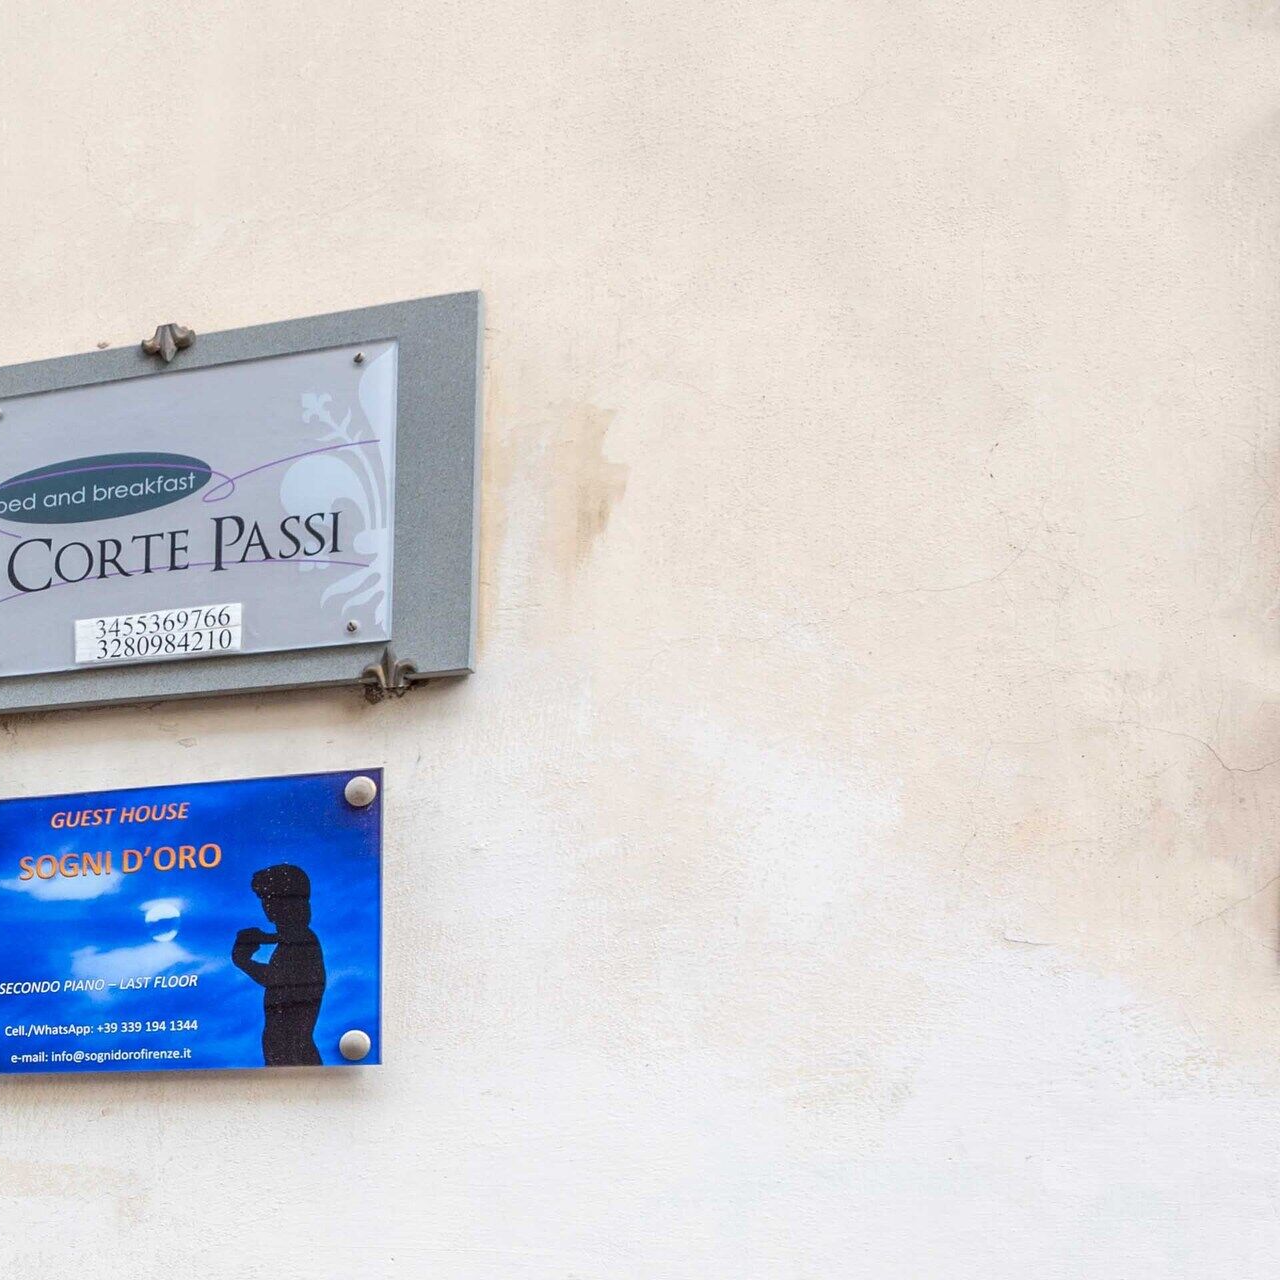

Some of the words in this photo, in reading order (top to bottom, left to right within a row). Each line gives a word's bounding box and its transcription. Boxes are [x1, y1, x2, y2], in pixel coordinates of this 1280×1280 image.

[43, 486, 86, 508] and
[93, 472, 196, 501] breakfast
[7, 529, 190, 593] CORTE
[210, 511, 343, 572] PASSI
[95, 605, 231, 639] 3455369766
[96, 628, 232, 659] 3280984210
[50, 807, 116, 829] GUEST
[119, 802, 190, 824] HOUSE
[18, 850, 112, 881] SOGNI
[122, 843, 223, 874] D’ORO
[63, 978, 105, 992] PIANO
[119, 976, 151, 990] LAST
[154, 974, 198, 988] FLOOR
[4, 1023, 94, 1038] Cell./WhatsApp:
[96, 1021, 118, 1034] +39
[121, 1021, 142, 1033] 339
[145, 1020, 166, 1032] 194
[170, 1019, 198, 1031] 1344
[11, 1051, 48, 1064] e-mail:
[51, 1048, 192, 1065] info@sognidorofirenze.it
